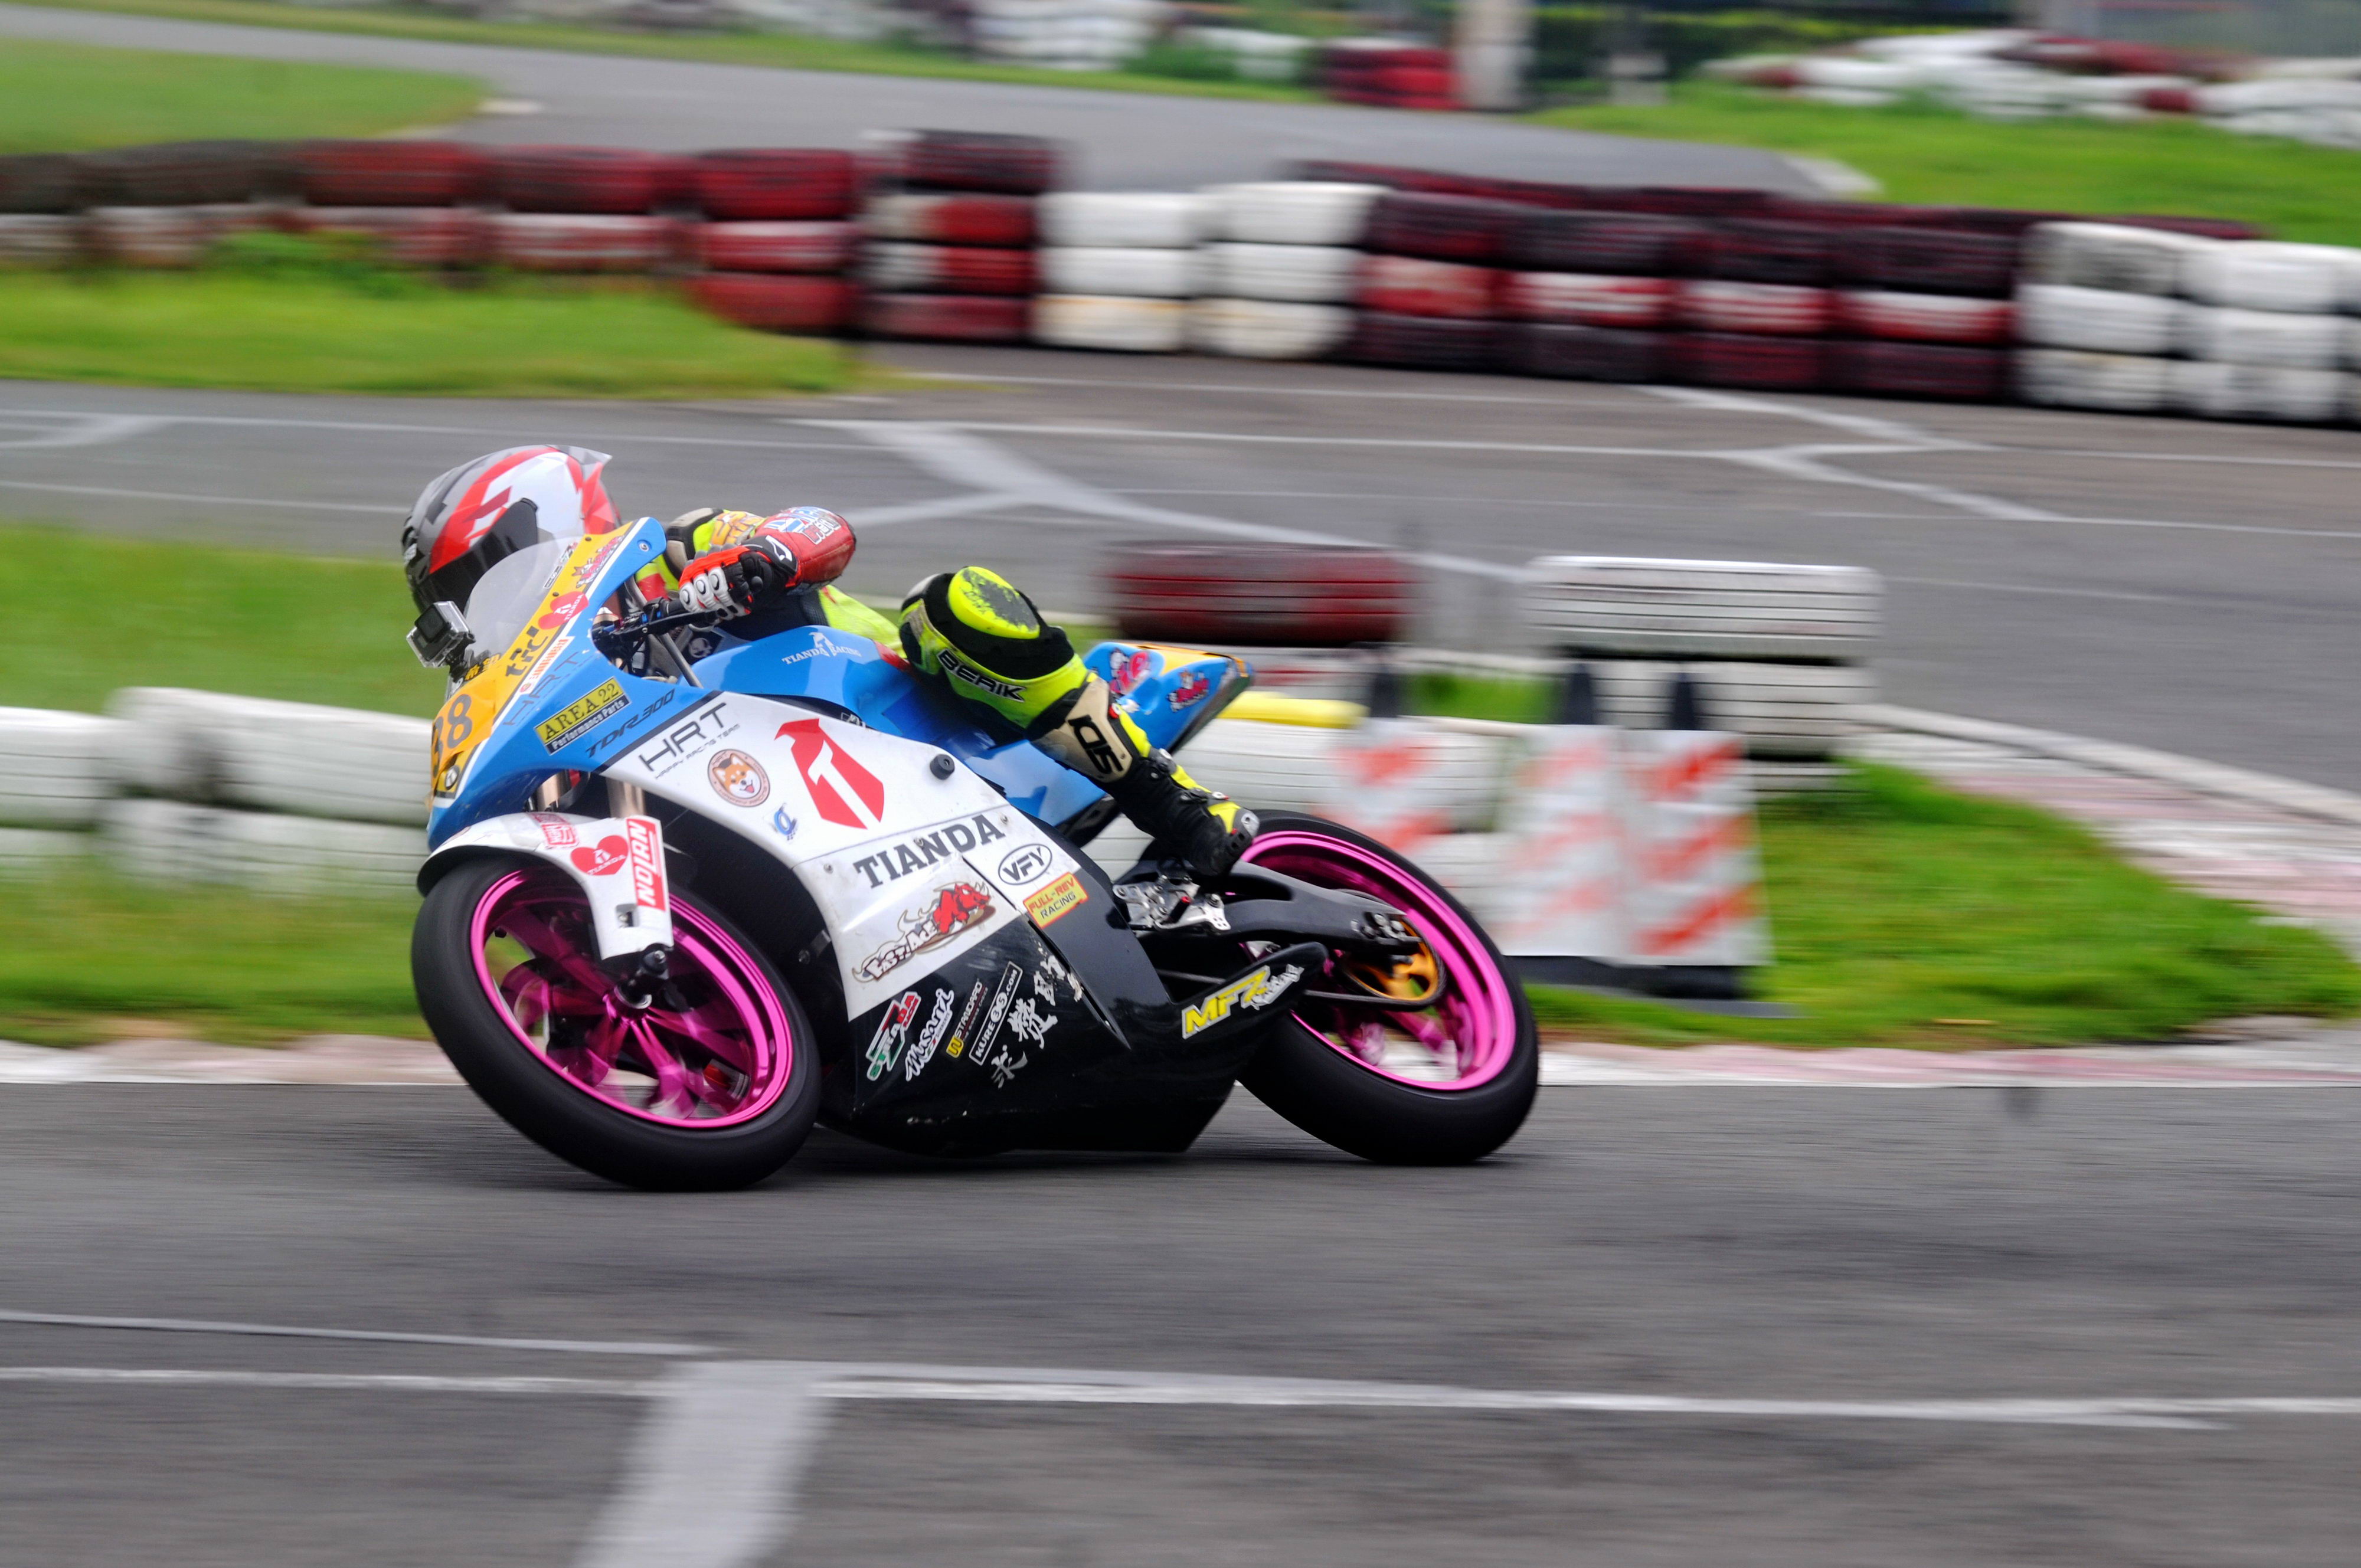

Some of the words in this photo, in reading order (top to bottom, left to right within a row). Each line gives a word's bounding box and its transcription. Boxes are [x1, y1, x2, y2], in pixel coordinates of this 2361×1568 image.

[781, 647, 830, 664] TIANDA
[829, 645, 862, 657] RACING
[938, 650, 1025, 703] BERIK
[545, 698, 599, 740] AREA
[599, 683, 619, 703] 22
[551, 712, 604, 751] Performance
[603, 699, 625, 717] Parts
[639, 702, 727, 772] HRT
[628, 820, 658, 907] NOLAN
[853, 814, 1006, 887] TIANDA
[1002, 846, 1045, 881] VFY
[1028, 878, 1075, 912] FULL-REV
[1040, 891, 1076, 919] RACING
